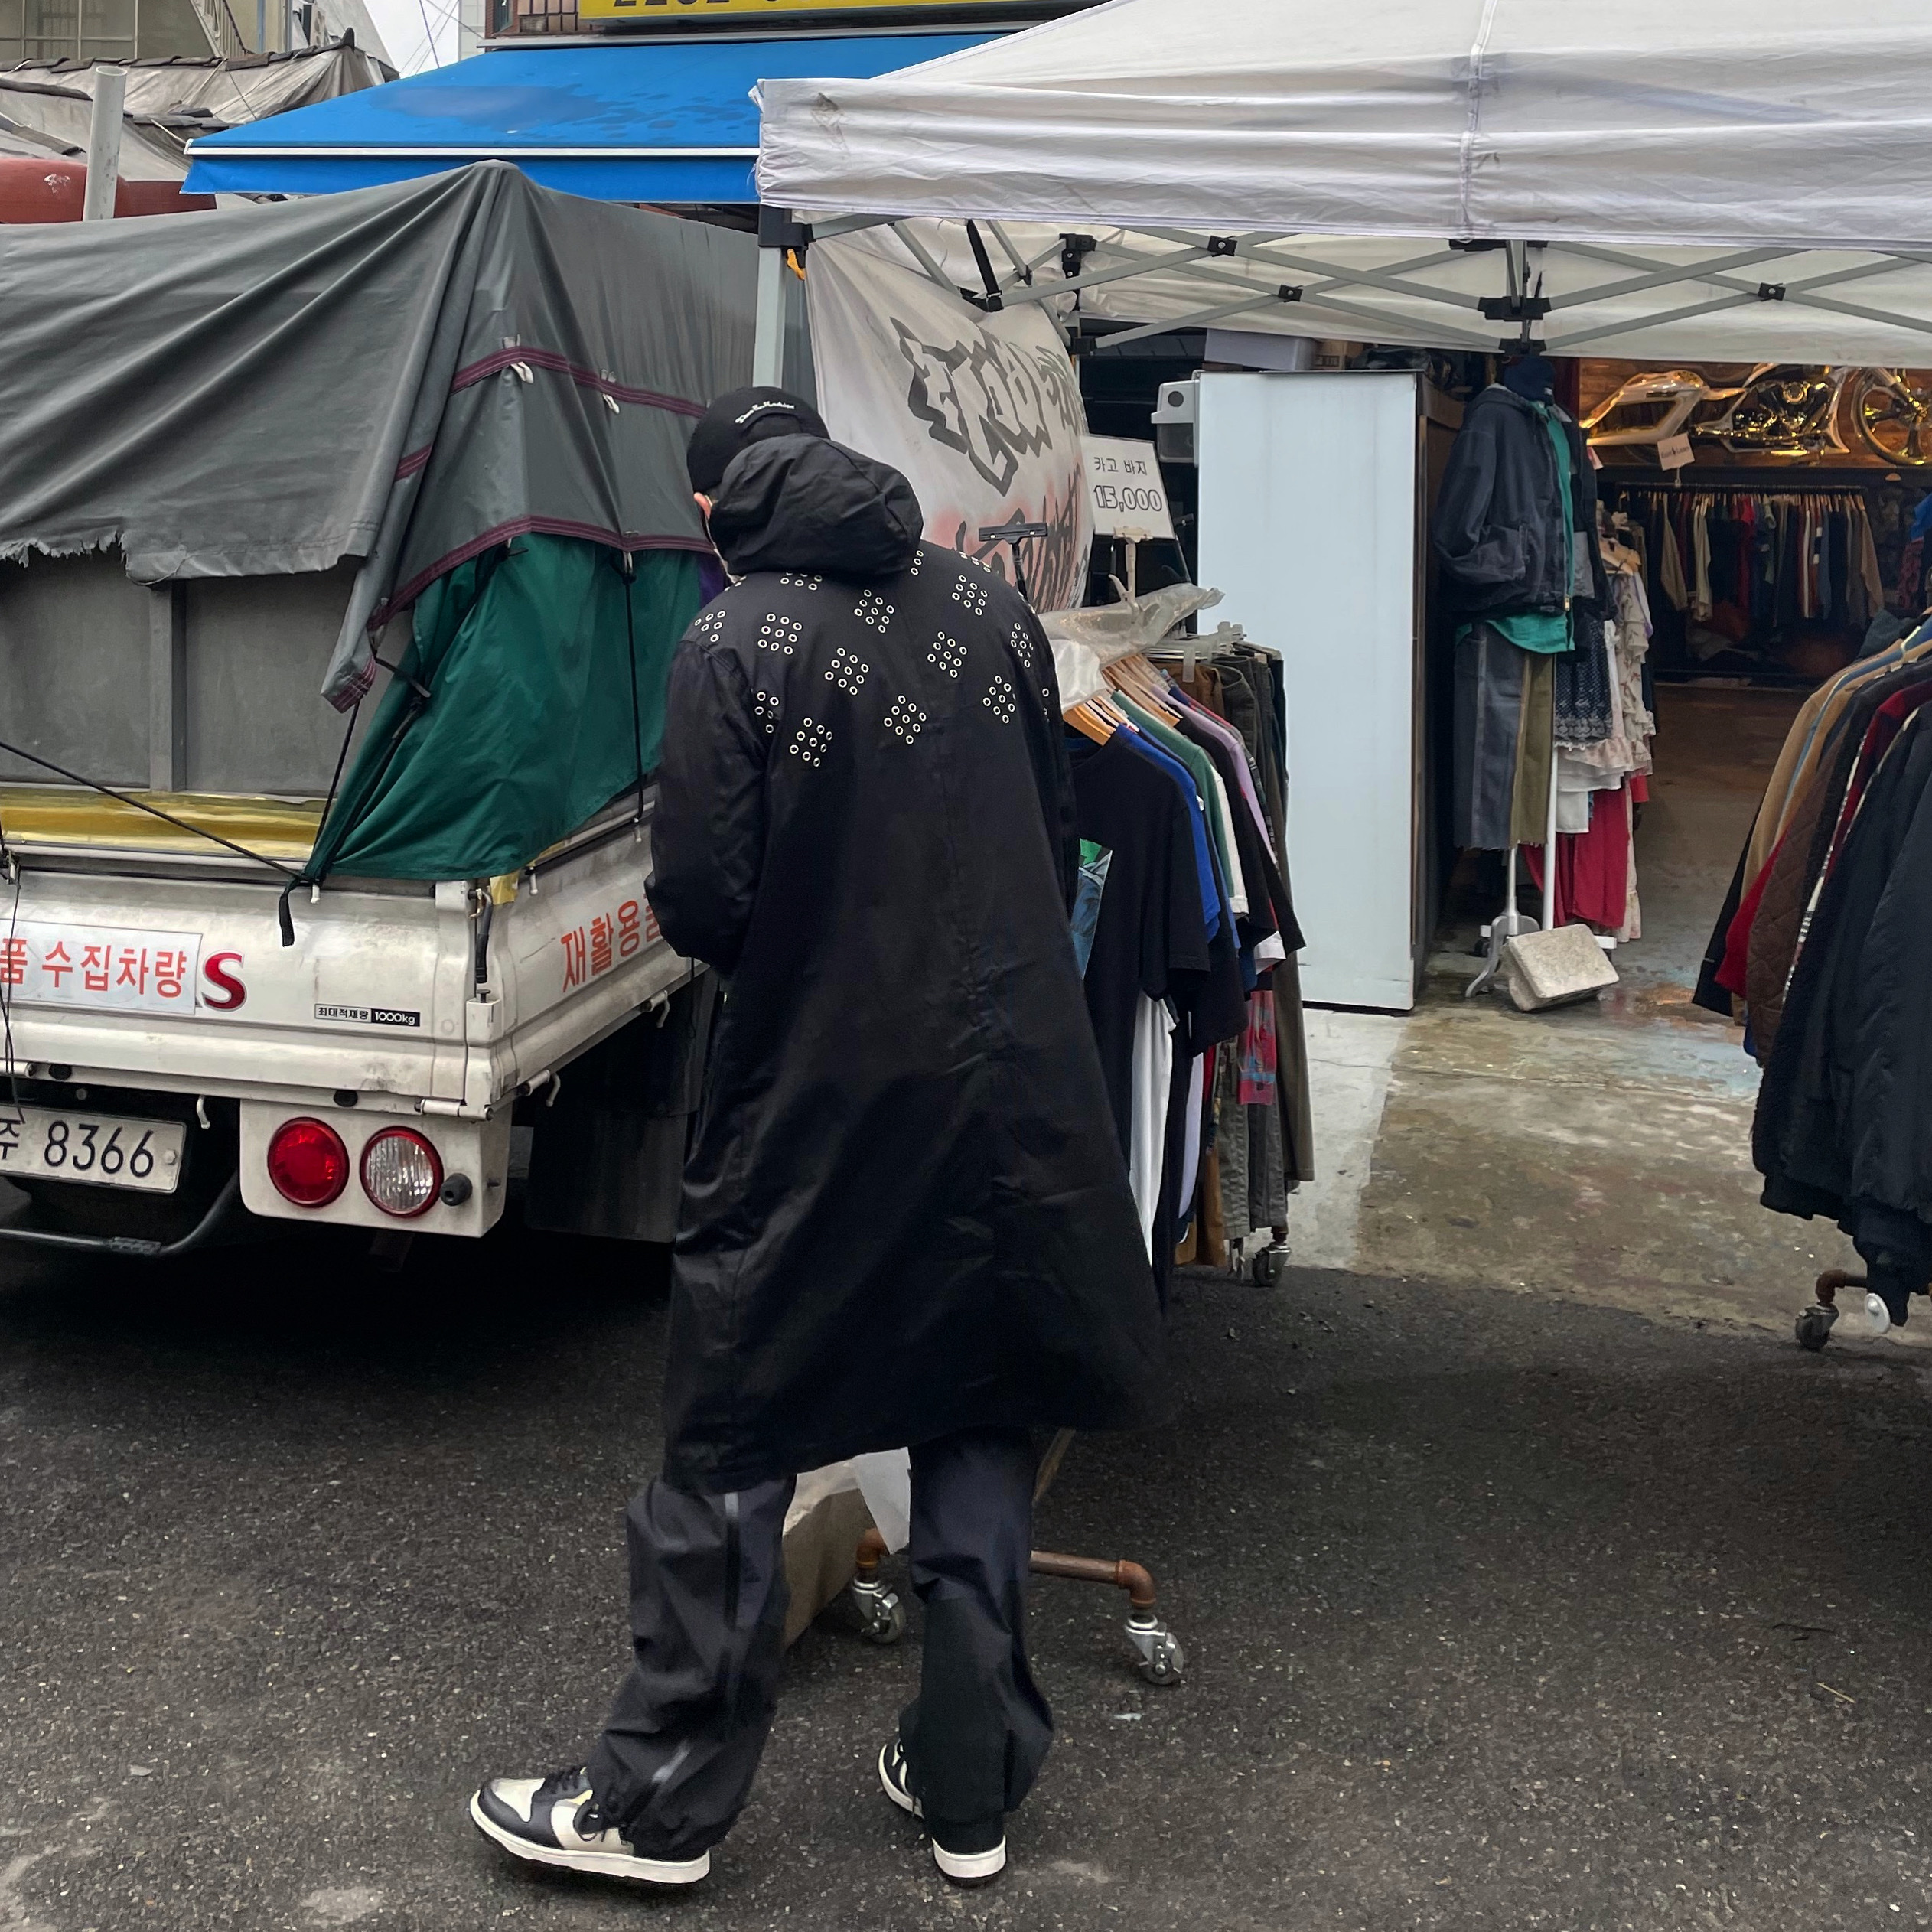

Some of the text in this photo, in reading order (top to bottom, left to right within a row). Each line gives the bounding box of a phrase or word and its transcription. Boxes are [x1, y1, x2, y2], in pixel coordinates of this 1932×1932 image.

[1093, 457, 1147, 475] 카고 바지
[1093, 484, 1162, 512] 15,000
[41, 941, 187, 998] 수집차량
[201, 950, 247, 1012] S
[375, 1011, 415, 1025] 1000kg
[44, 1120, 154, 1178] 8366
